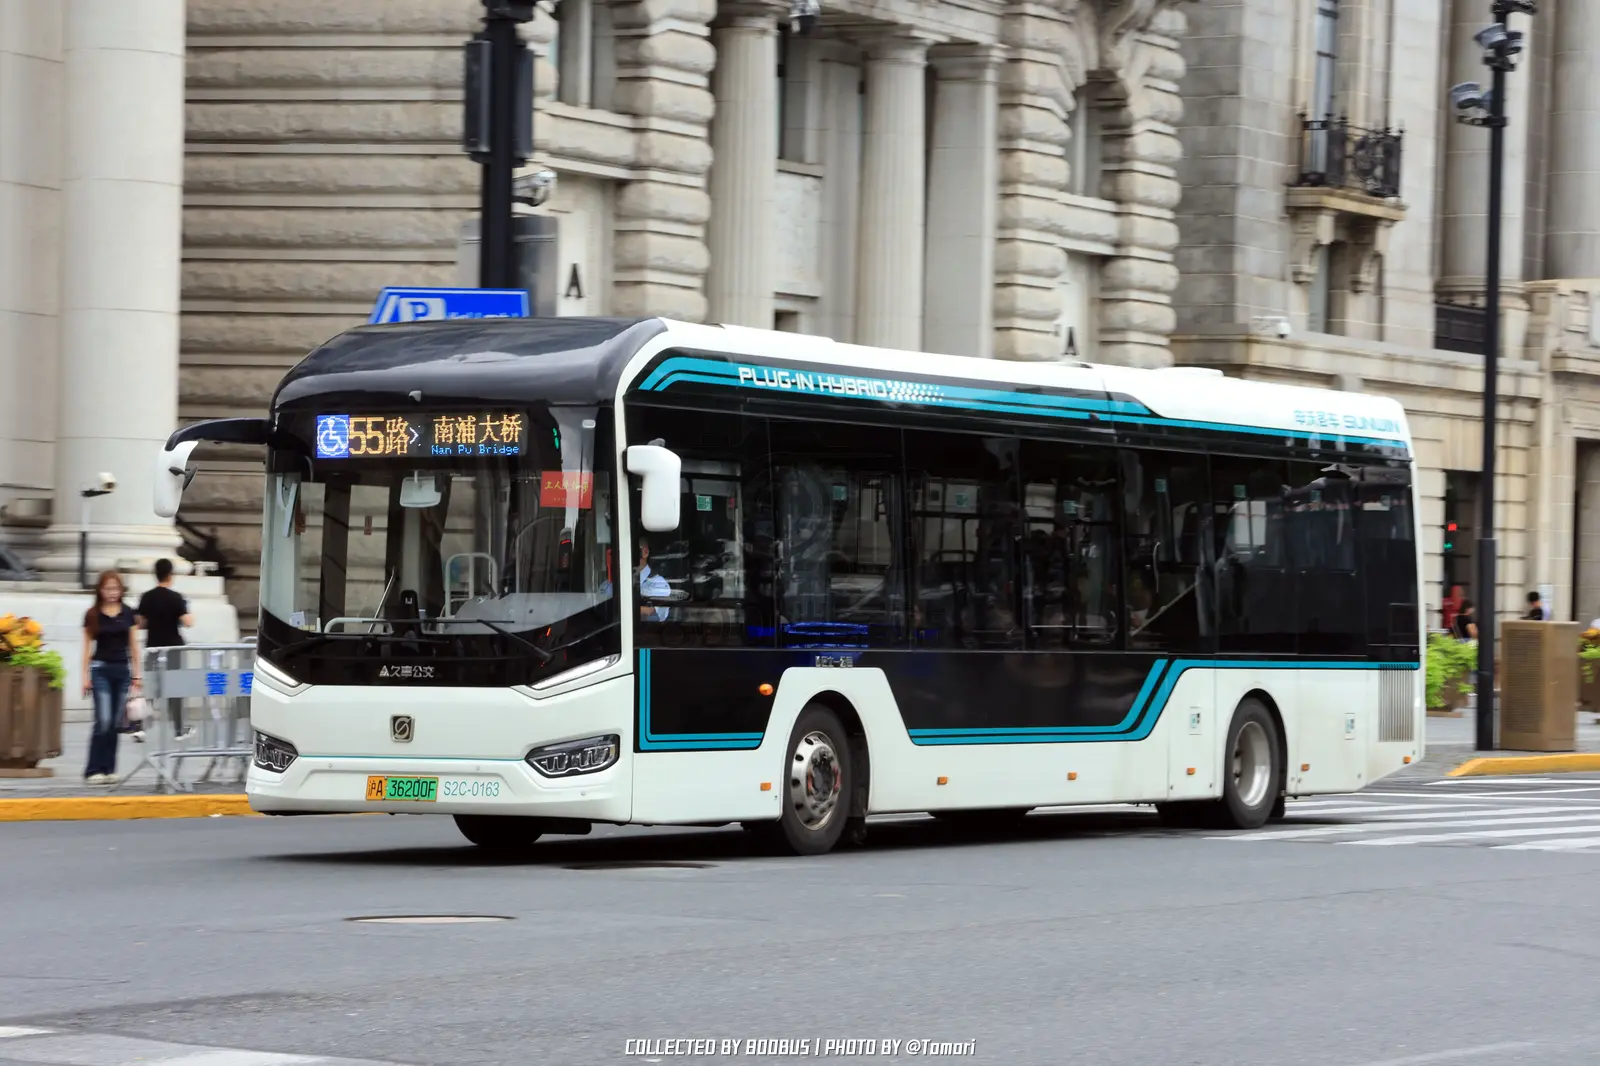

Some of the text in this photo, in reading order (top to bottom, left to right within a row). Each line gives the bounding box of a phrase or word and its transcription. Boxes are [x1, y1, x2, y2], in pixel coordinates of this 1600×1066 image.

[565, 263, 583, 298] A
[738, 367, 888, 398] PLUG-IN HYBRID
[349, 414, 522, 455] 55路 南浦大桥
[431, 445, 520, 456] Nan Pu Bridge
[444, 781, 500, 797] S2C-0163
